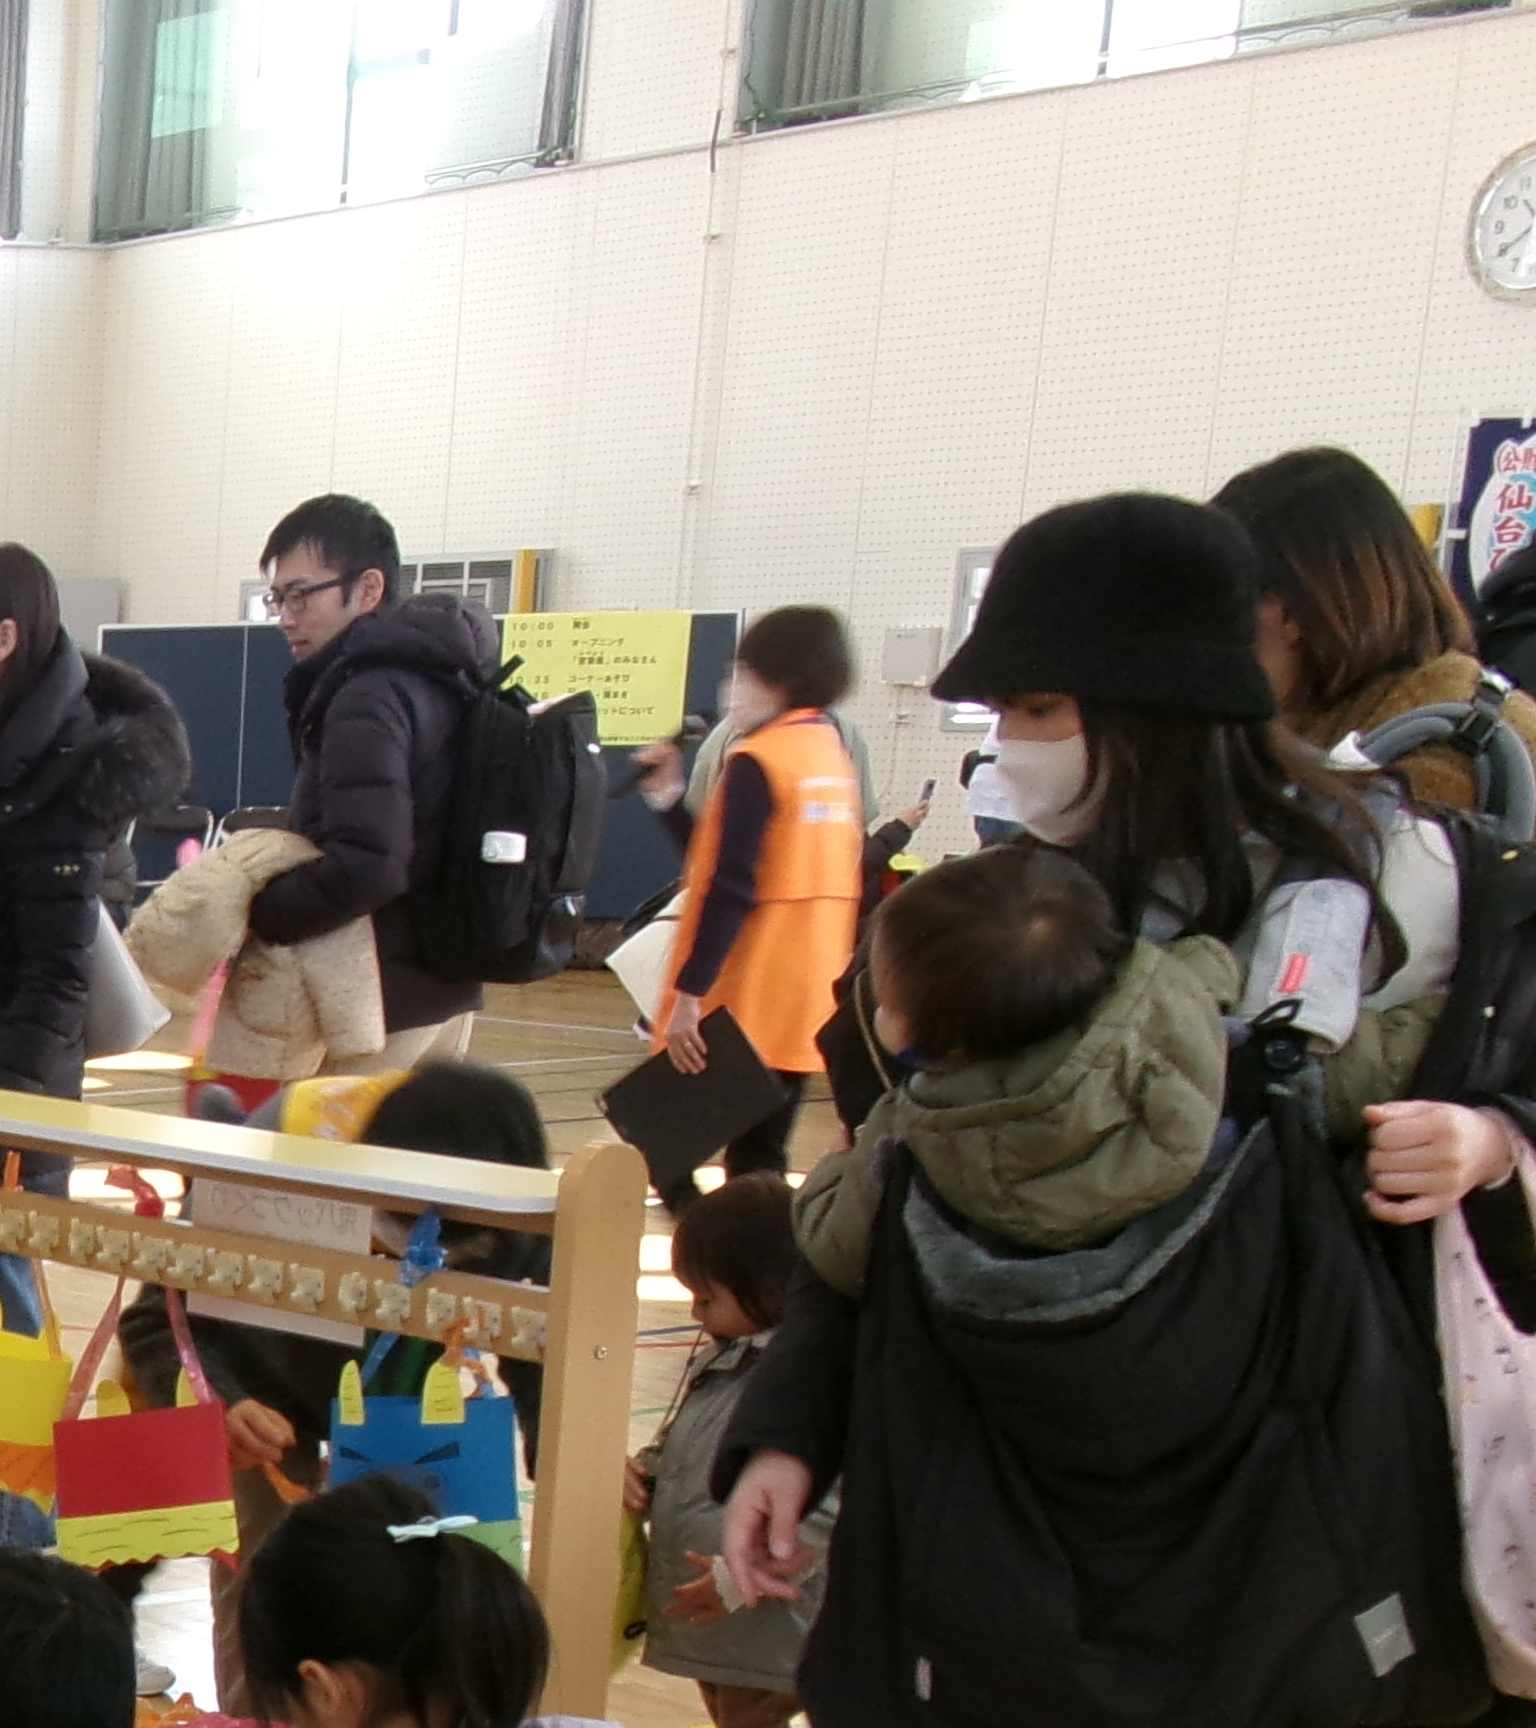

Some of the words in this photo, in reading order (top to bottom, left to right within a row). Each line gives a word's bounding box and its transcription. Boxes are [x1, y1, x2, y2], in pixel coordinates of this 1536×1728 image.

[1503, 195, 1519, 210] 10
[1494, 219, 1505, 235] 9
[1511, 257, 1521, 273] 7
